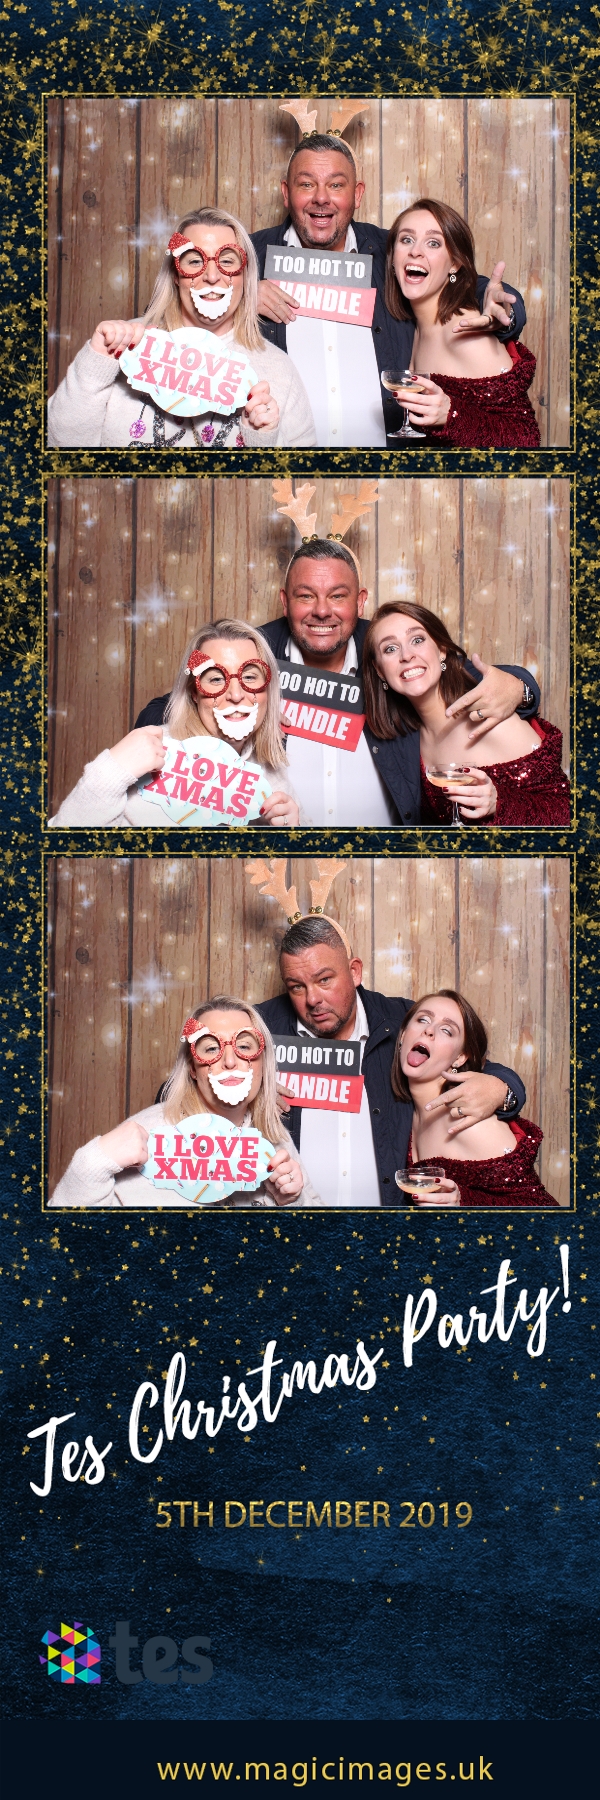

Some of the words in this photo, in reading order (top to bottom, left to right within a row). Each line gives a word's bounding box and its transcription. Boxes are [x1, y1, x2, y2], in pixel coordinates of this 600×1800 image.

[273, 255, 305, 274] TOO
[308, 257, 341, 277] HOT
[344, 260, 365, 279] TO
[140, 335, 152, 358] I
[159, 340, 247, 384] LOVE
[133, 358, 239, 407] XMAS
[278, 670, 302, 692] OO
[303, 676, 338, 698] HOT
[340, 683, 361, 704] TO
[171, 750, 260, 796] LOVE
[143, 770, 252, 818] XMAS
[273, 1044, 298, 1064] OO
[301, 1046, 332, 1065] HOT
[335, 1048, 355, 1067] TO
[154, 1134, 165, 1156] I
[174, 1134, 259, 1158] LOVE
[154, 1158, 258, 1183] XMAS
